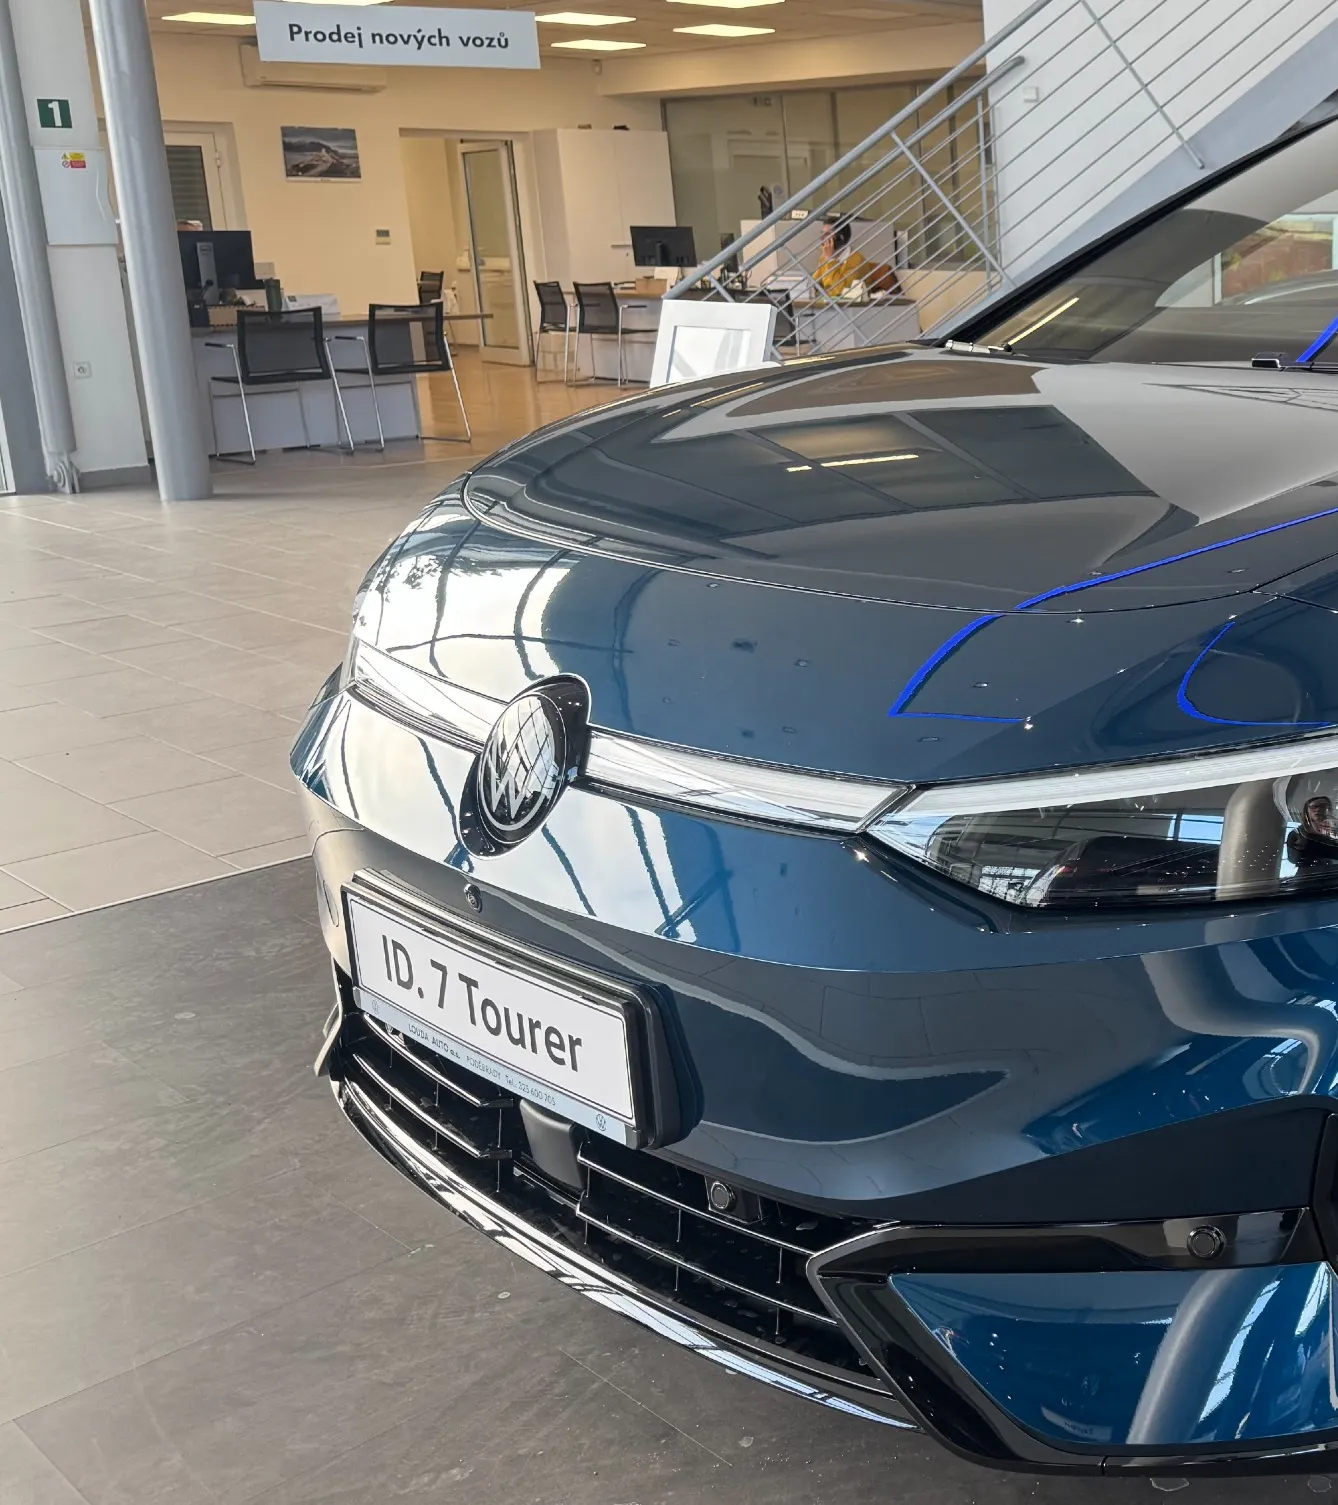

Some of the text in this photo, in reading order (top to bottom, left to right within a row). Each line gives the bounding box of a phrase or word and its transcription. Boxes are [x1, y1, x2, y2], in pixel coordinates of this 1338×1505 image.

[288, 23, 509, 51] Prodej nových vozů
[48, 101, 62, 127] 1
[458, 972, 583, 1073] Tourer
[408, 1023, 430, 1042] LOUDA
[431, 1036, 449, 1053] AUTO
